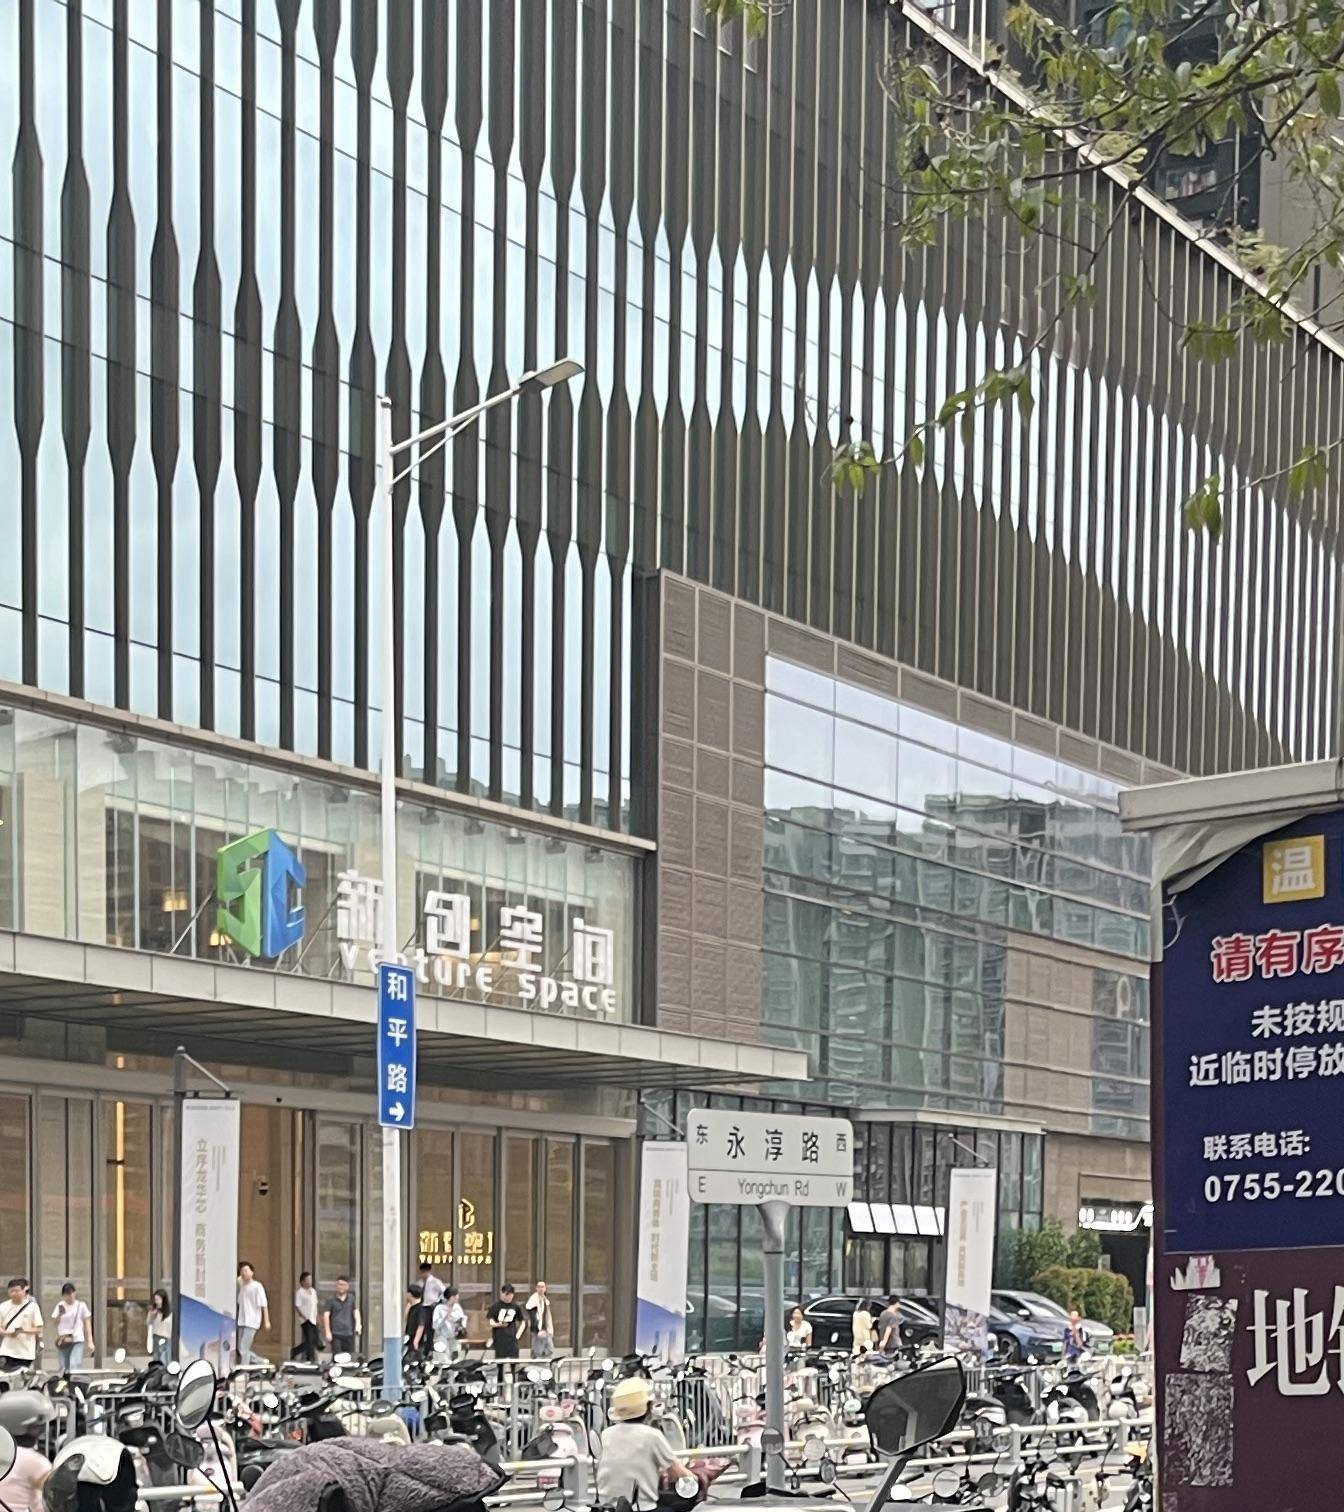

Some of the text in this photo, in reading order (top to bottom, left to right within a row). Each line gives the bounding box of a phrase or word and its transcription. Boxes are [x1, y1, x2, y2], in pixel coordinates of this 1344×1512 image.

[519, 974, 616, 1013] space
[387, 972, 408, 1094] 和平路
[696, 1124, 847, 1163] 东 永淳路 西
[698, 1176, 848, 1200] E Yongchun Rd W
